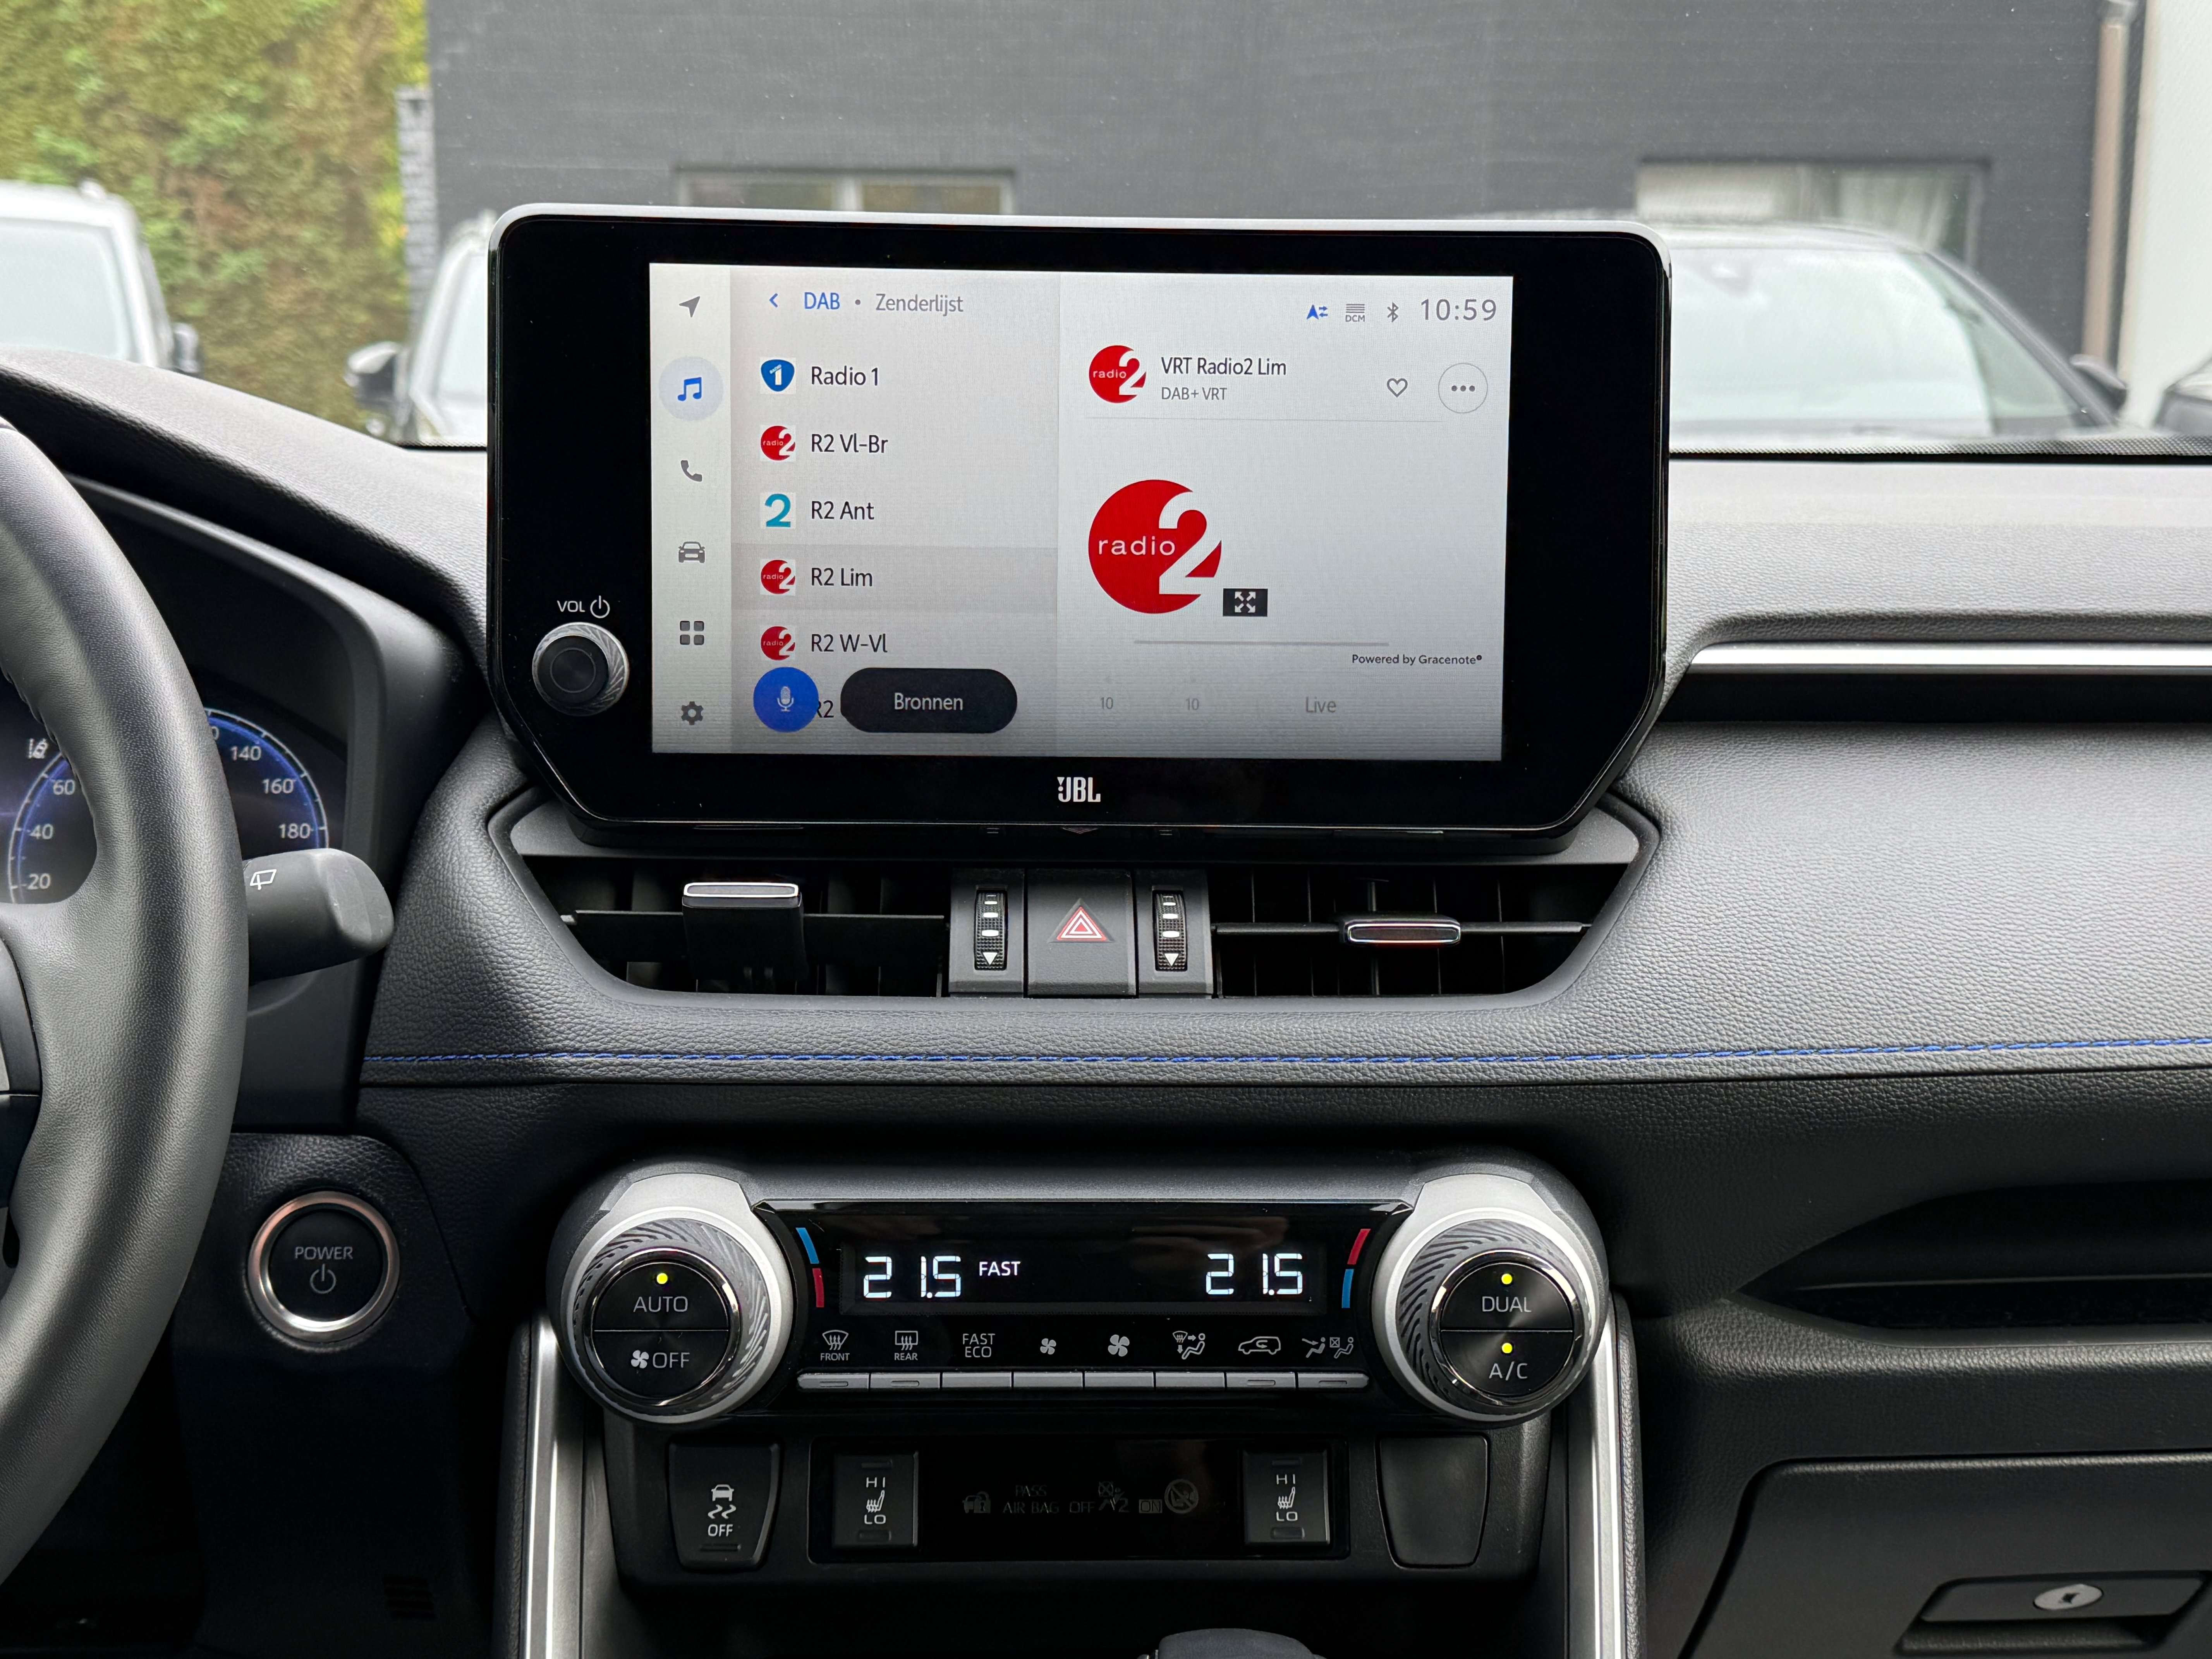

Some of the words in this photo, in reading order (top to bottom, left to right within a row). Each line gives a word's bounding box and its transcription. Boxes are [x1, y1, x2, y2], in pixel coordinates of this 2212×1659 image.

[804, 292, 840, 310] DAB
[875, 293, 964, 317] Zenderlijst
[1420, 299, 1497, 321] 10:59
[1345, 314, 1366, 323] DCM
[1092, 368, 1127, 380] radio
[1161, 357, 1193, 374] VRT
[1197, 357, 1253, 376] Radio2
[1257, 359, 1287, 376] Lim
[811, 366, 867, 386] Radio
[871, 367, 880, 386] 1
[1161, 387, 1199, 401] DAB+
[1202, 388, 1228, 401] VRT
[811, 434, 835, 453] R2
[765, 494, 791, 527] 2
[811, 501, 835, 520] R2
[840, 501, 874, 520] Ant
[1098, 536, 1176, 556] radio
[811, 568, 834, 586] R2
[840, 568, 873, 586] Lim
[557, 601, 585, 613] VOL
[811, 634, 834, 653] R2
[1352, 654, 1399, 663] Powered
[1403, 654, 1416, 665] by
[893, 693, 963, 711] Bronnen
[1101, 697, 1113, 709] 10
[1186, 698, 1199, 711] 10
[1305, 697, 1336, 714] Live
[232, 746, 261, 761] 140
[53, 780, 76, 795] 60
[263, 779, 294, 794] 160
[1057, 777, 1101, 802] JBL
[30, 825, 53, 840] 40
[279, 824, 311, 839] 180
[28, 874, 51, 889] 20
[295, 1246, 353, 1259] POWER
[979, 1261, 1020, 1276] FAST
[633, 1296, 688, 1312] AUTO
[1482, 1296, 1532, 1312] DUAL
[962, 1333, 995, 1345] FAST
[820, 1353, 850, 1361] FRONT
[893, 1353, 918, 1361] REAR
[965, 1347, 992, 1358] ECO
[653, 1353, 690, 1368] OFF
[1489, 1362, 1528, 1381] A/C
[864, 1477, 887, 1488] HI
[1276, 1474, 1296, 1485] HI
[1015, 1485, 1047, 1497] PASS
[1003, 1501, 1024, 1514] AIR
[1031, 1501, 1060, 1514] BAG
[1069, 1501, 1096, 1514] OFF
[1139, 1499, 1163, 1513] ON
[864, 1515, 886, 1525] LO
[1276, 1512, 1297, 1521] LO
[707, 1523, 733, 1537] OFF
